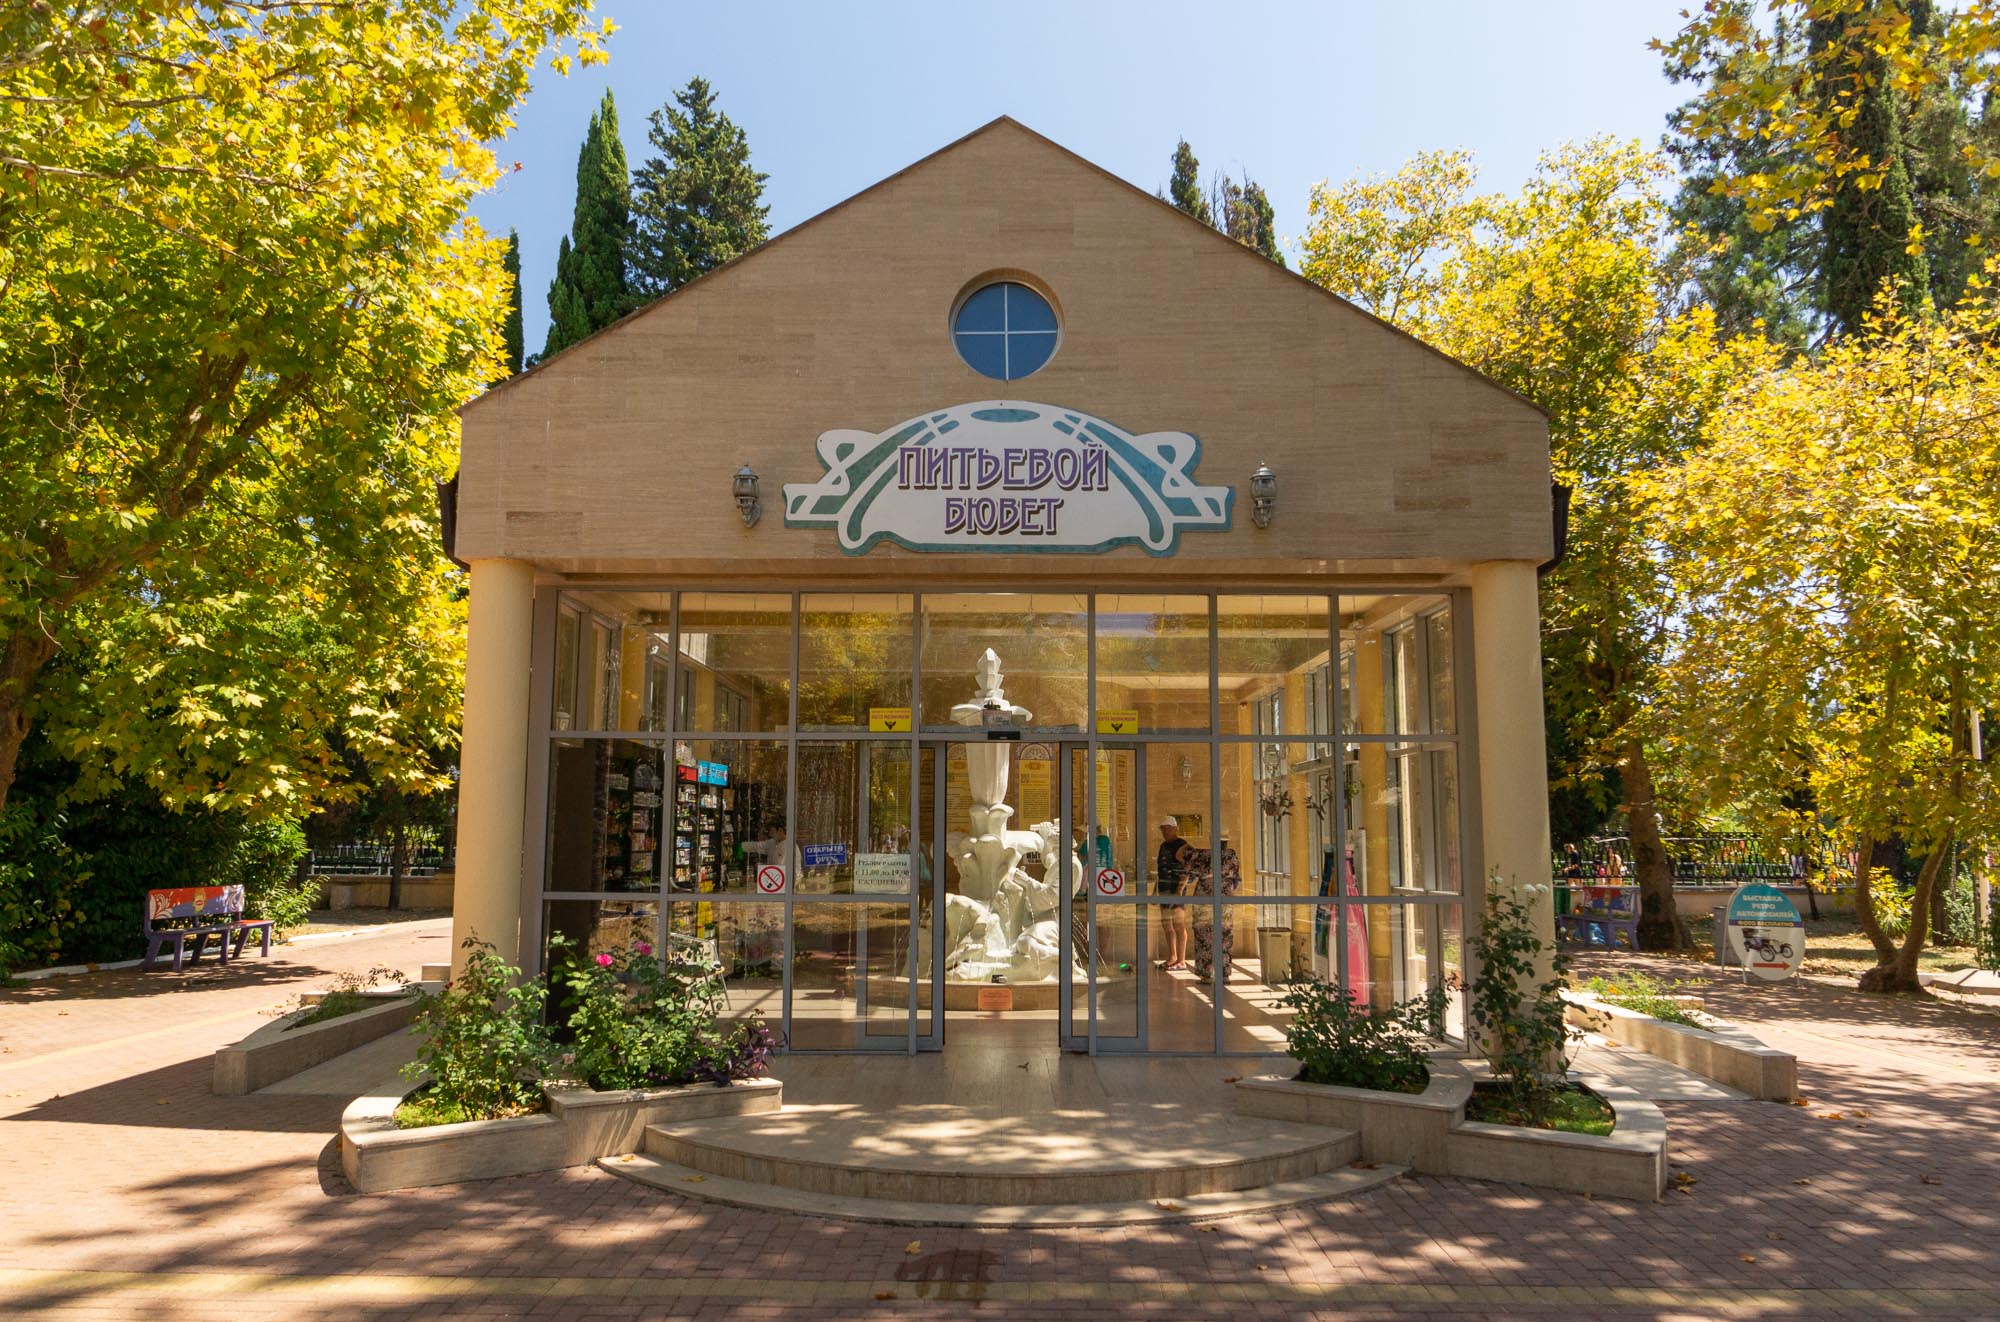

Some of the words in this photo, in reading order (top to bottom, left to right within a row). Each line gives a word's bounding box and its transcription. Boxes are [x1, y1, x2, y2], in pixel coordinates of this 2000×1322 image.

[898, 443, 1109, 490] ПИТЬЕВОЙ
[944, 496, 1064, 535] БЮВЕТ
[807, 845, 844, 854] ОТКРЫТО
[1736, 910, 1795, 918] АВТОМОБИЛЕЙ
